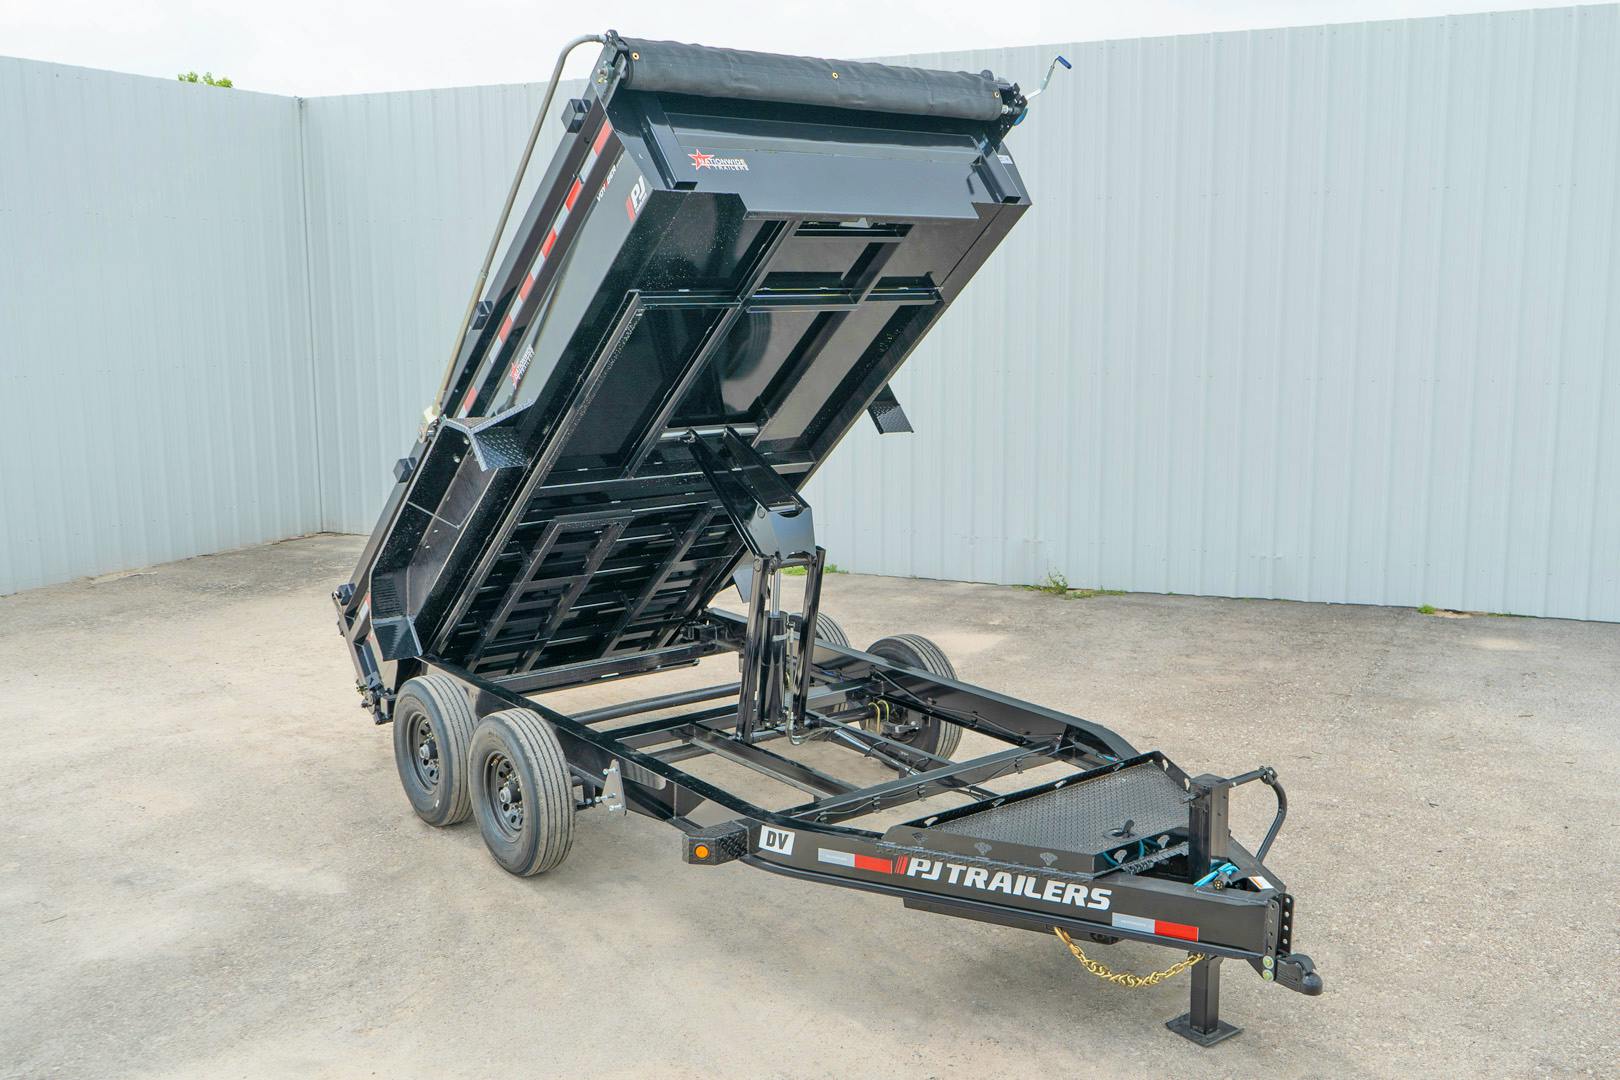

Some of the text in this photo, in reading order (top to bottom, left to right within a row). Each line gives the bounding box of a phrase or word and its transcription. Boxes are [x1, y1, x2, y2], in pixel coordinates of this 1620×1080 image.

[630, 174, 646, 210] PJ
[765, 830, 789, 850] DV
[906, 857, 1113, 911] PJ TRAILERS
